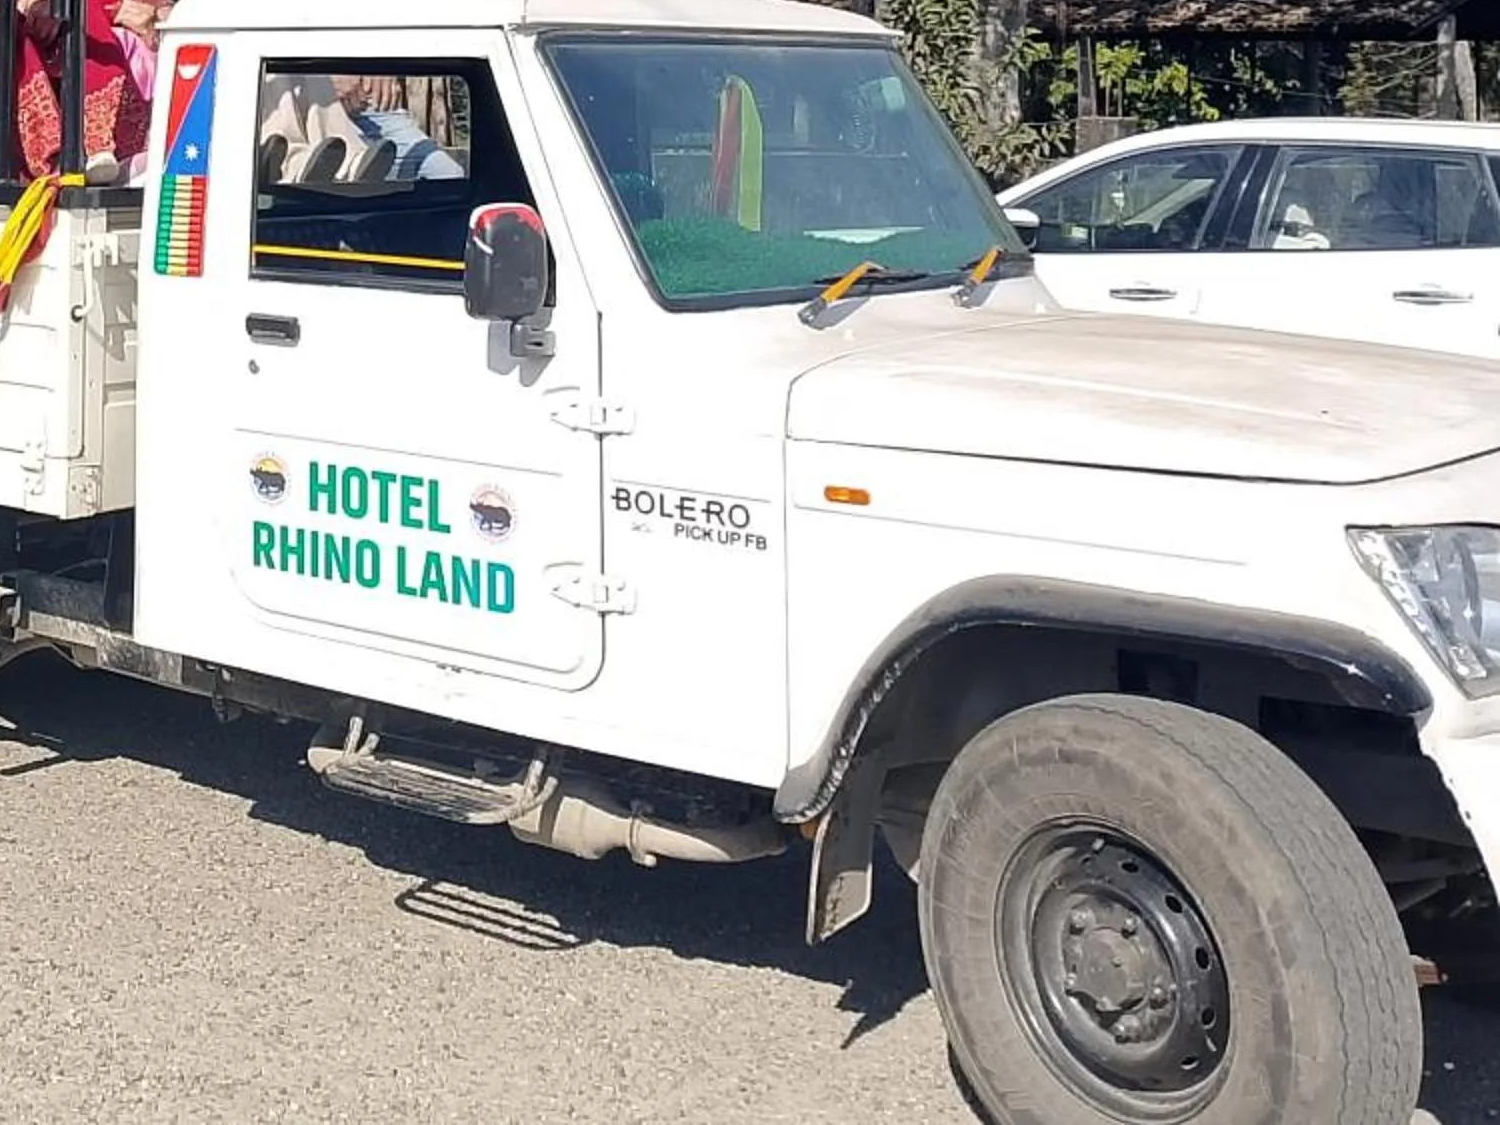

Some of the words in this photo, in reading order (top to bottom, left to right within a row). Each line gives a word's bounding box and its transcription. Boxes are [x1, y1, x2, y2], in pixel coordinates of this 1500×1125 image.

[308, 461, 451, 533] HOTEL
[611, 487, 750, 528] BOLERO
[674, 523, 714, 542] PICK
[717, 529, 741, 545] UP
[745, 533, 767, 551] FB
[252, 521, 381, 588] RHINO
[396, 546, 516, 614] LAND
